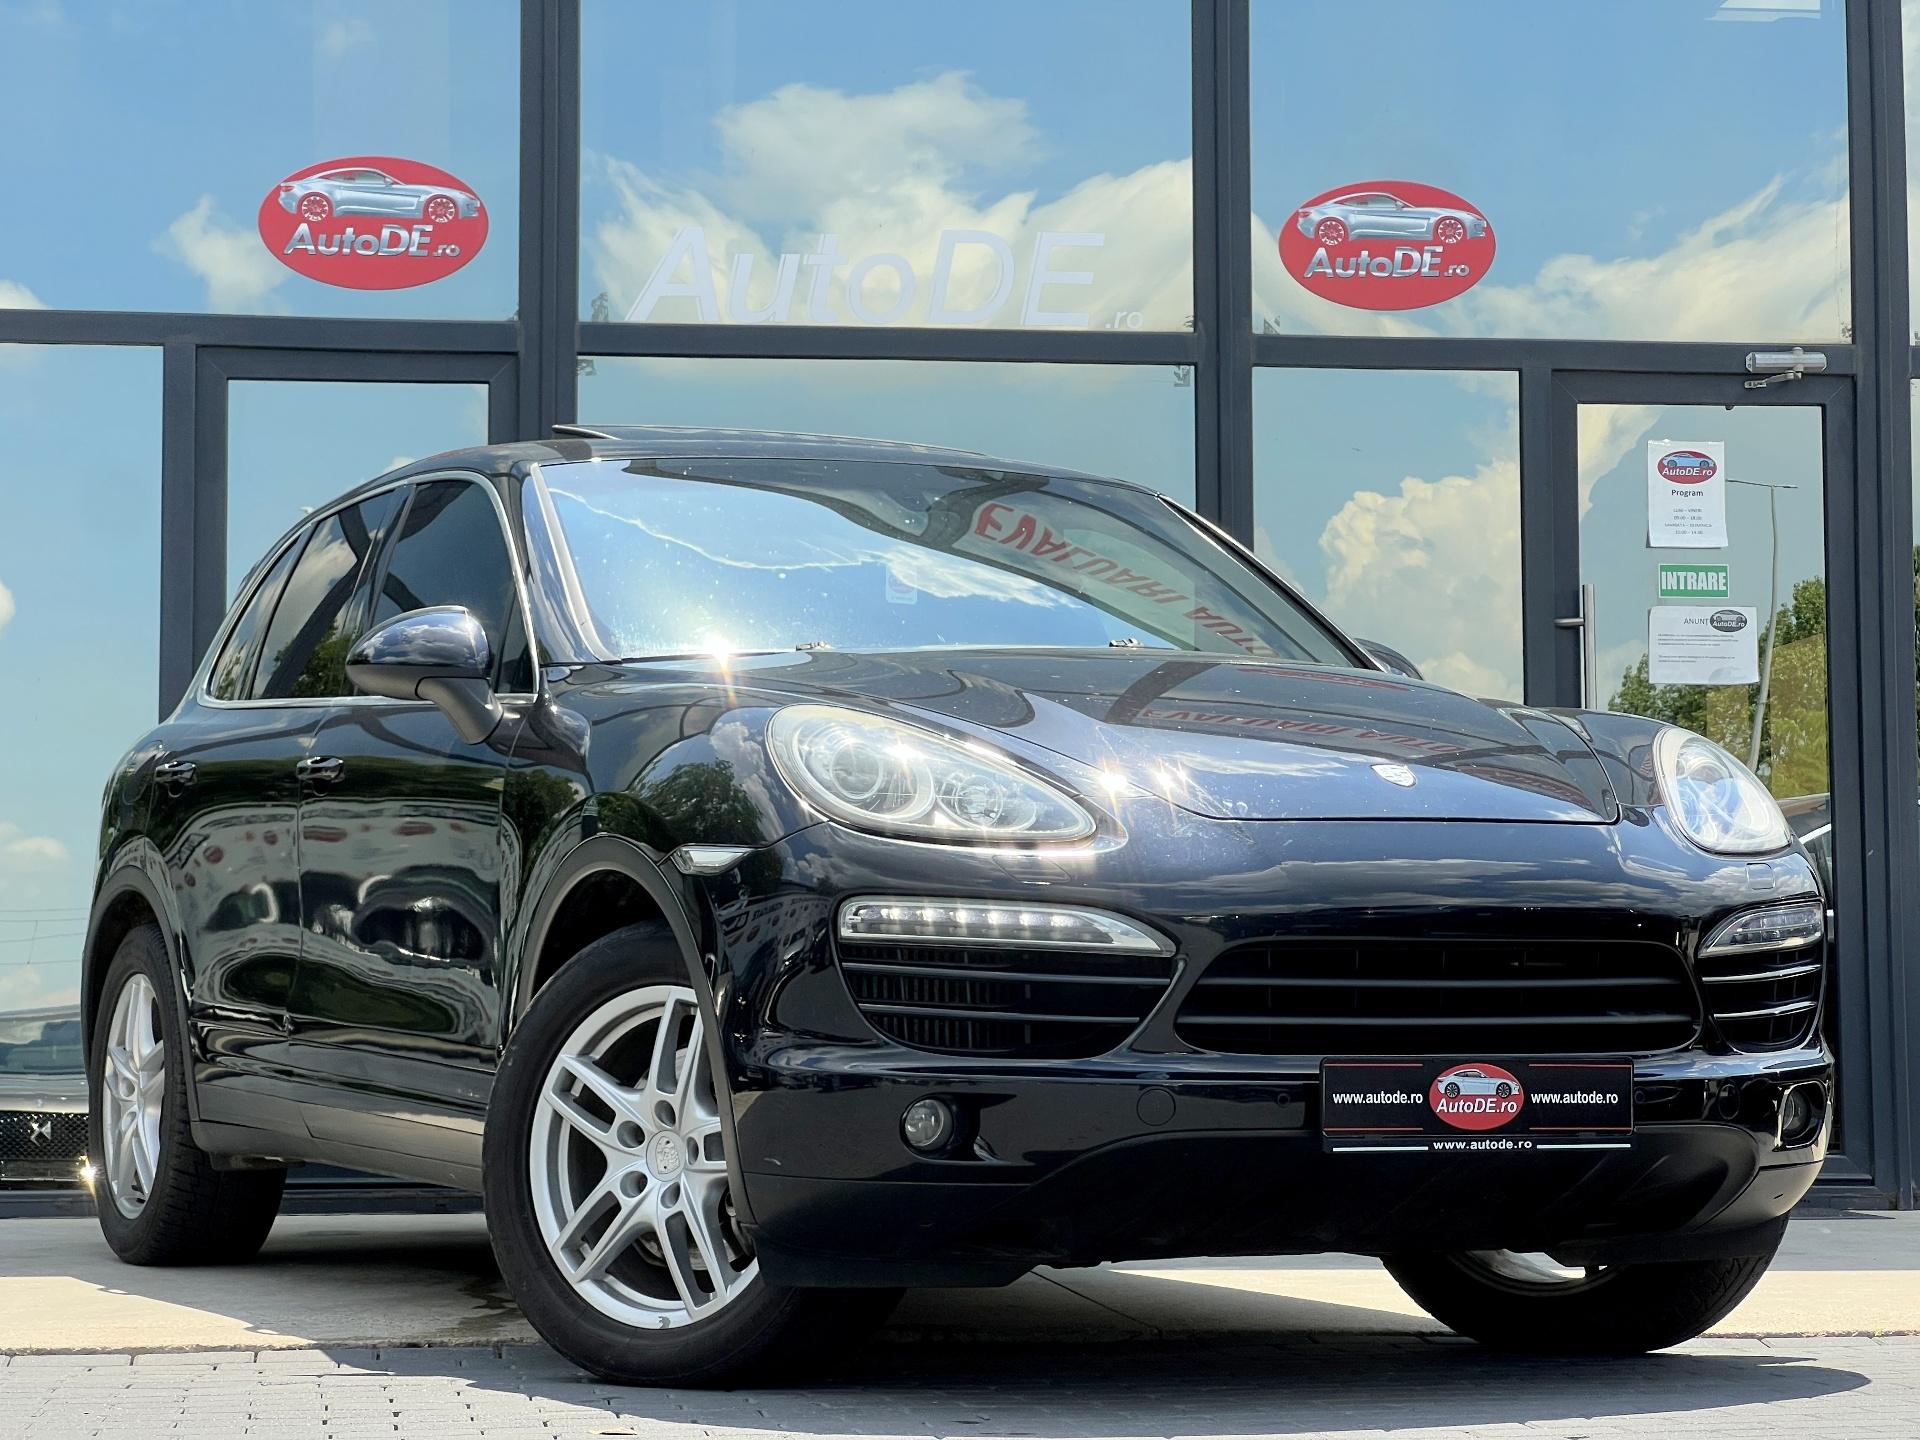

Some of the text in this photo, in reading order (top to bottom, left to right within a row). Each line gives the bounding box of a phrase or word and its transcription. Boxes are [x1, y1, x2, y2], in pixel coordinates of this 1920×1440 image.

[283, 222, 461, 257] AutoDE.ro
[1303, 246, 1470, 278] AutoDE.ro
[1662, 467, 1713, 476] AutoDE.ro
[1671, 489, 1704, 498] Program
[1661, 571, 1727, 591] INTRARE
[1332, 1090, 1424, 1104] www.autode.ro
[1530, 1090, 1619, 1104] www.autode.ro
[1435, 1098, 1518, 1114] AutoDE.ro
[1432, 1139, 1533, 1150] www.autode.ro
